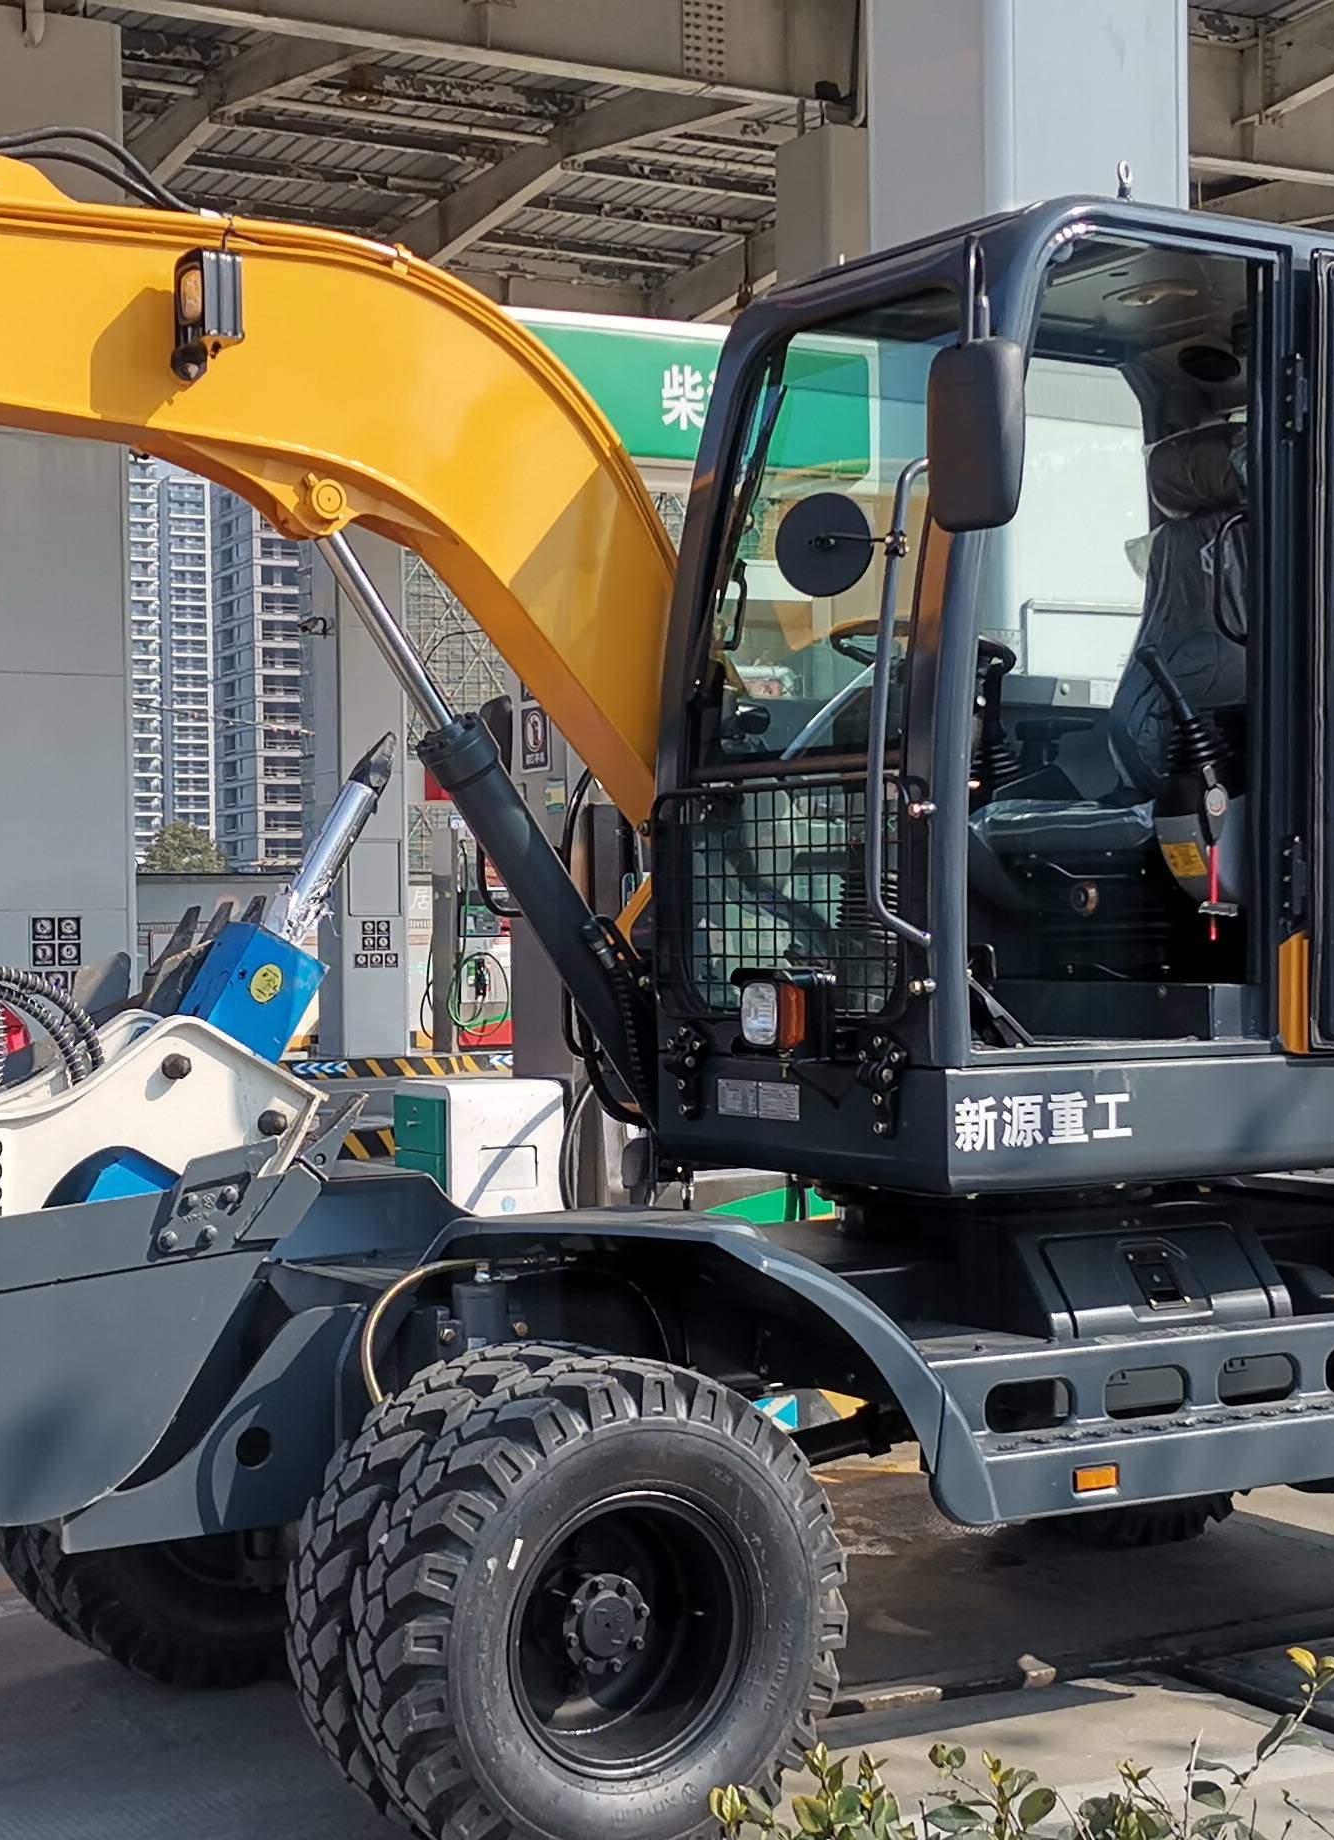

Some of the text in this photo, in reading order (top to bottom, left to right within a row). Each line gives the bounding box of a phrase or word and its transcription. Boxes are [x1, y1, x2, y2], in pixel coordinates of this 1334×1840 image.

[661, 364, 717, 431] 柴
[954, 1091, 1133, 1152] 新源重工
